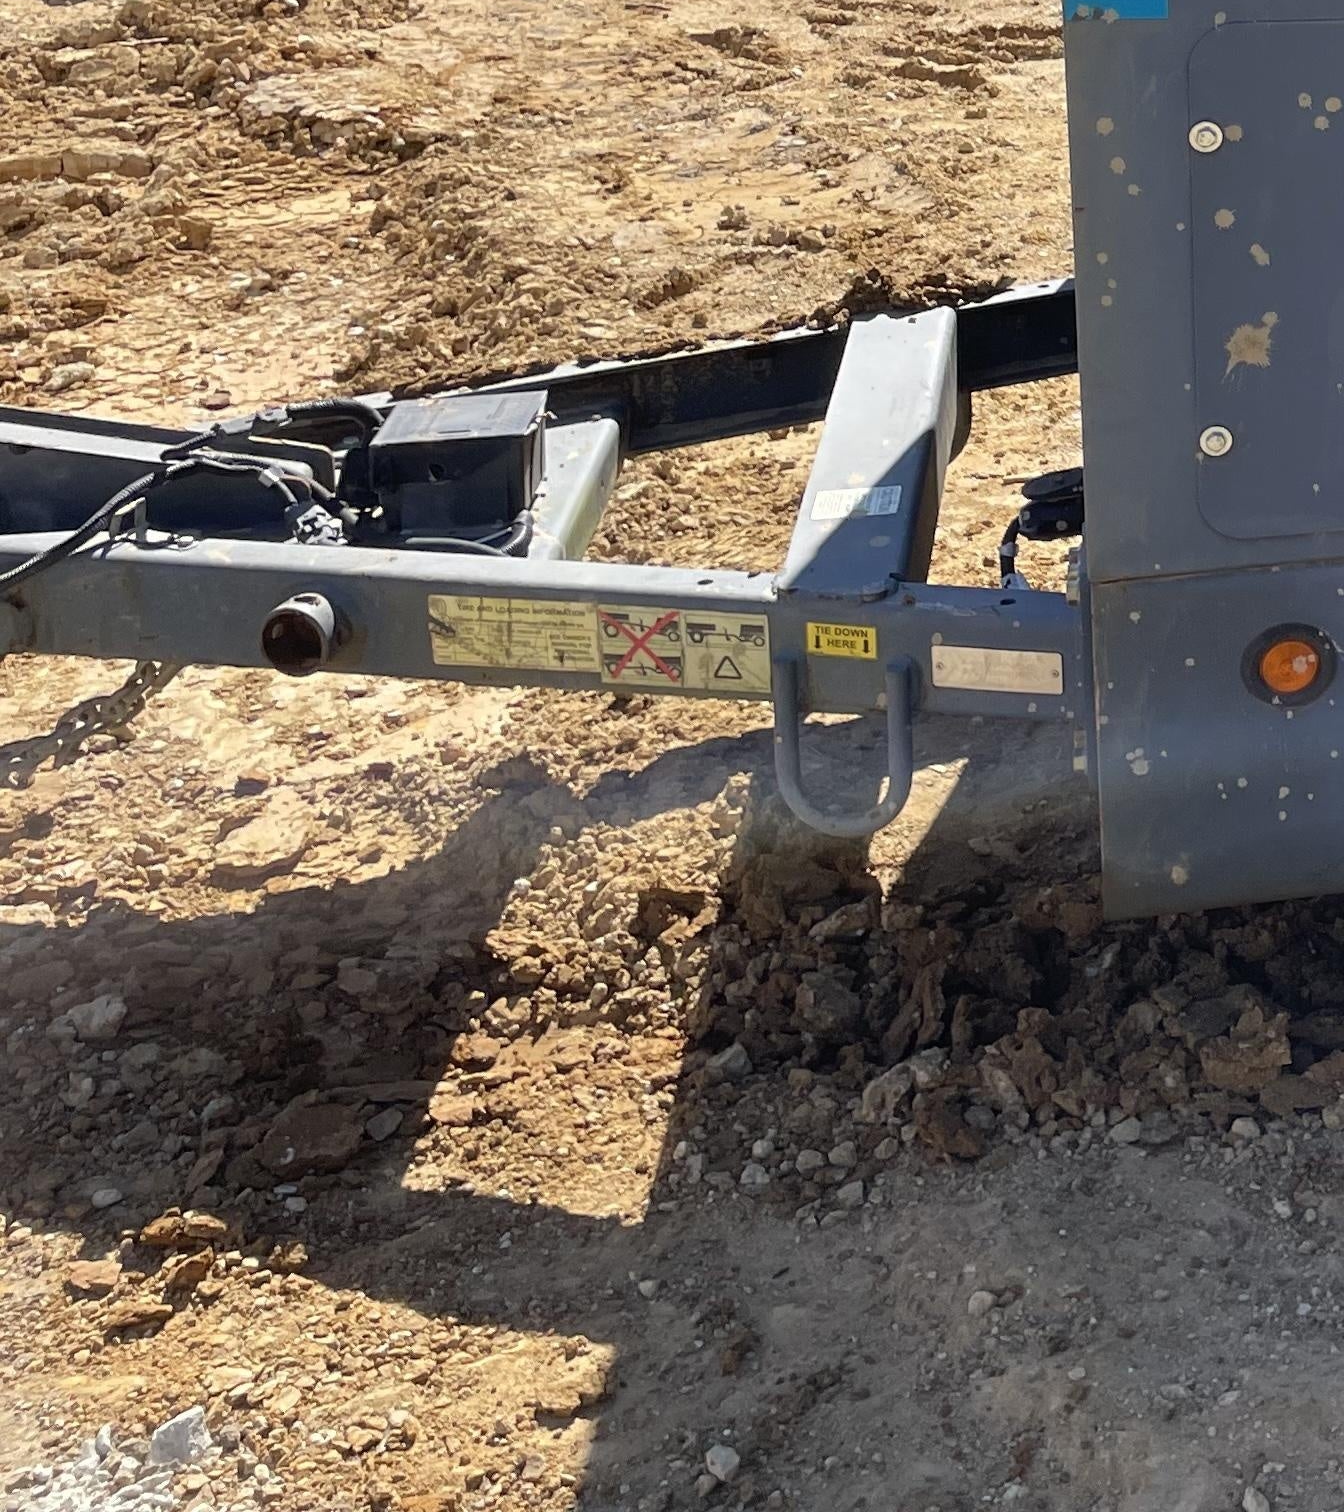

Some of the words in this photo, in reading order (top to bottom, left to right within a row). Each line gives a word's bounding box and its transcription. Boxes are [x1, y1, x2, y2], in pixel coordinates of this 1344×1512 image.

[815, 626, 831, 635] TIE
[834, 627, 868, 637] DOWN
[827, 639, 857, 648] HERE
